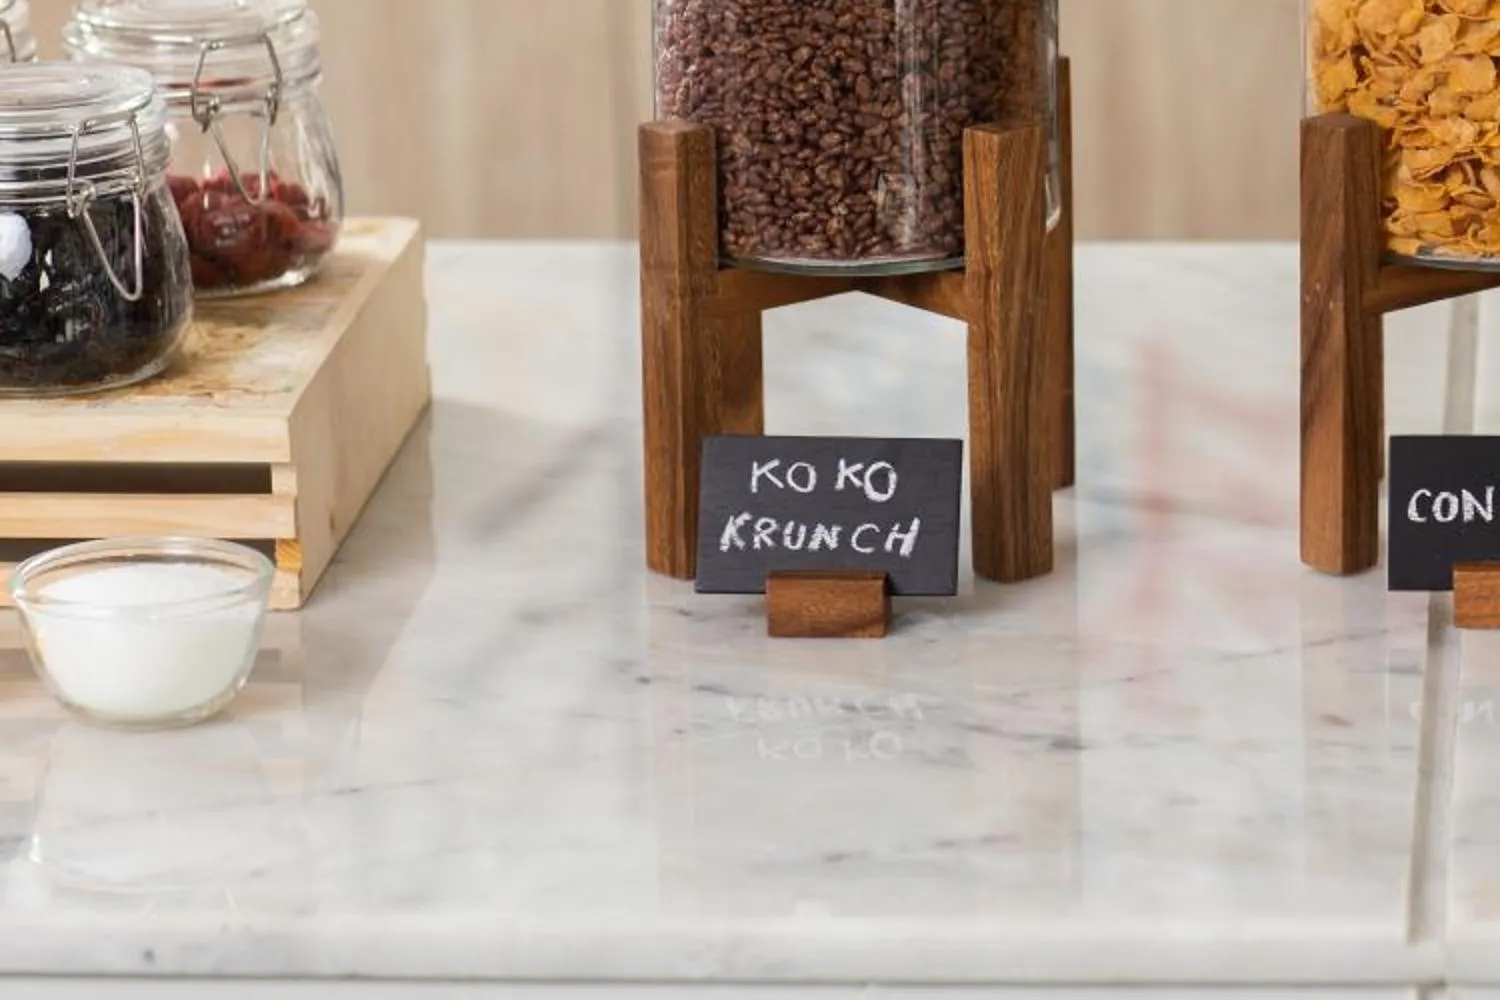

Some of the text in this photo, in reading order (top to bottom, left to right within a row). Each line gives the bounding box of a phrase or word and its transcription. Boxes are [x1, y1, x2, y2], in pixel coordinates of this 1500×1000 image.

[751, 458, 898, 502] KO KO
[1407, 486, 1495, 523] CON
[719, 511, 920, 557] KRUNCH
